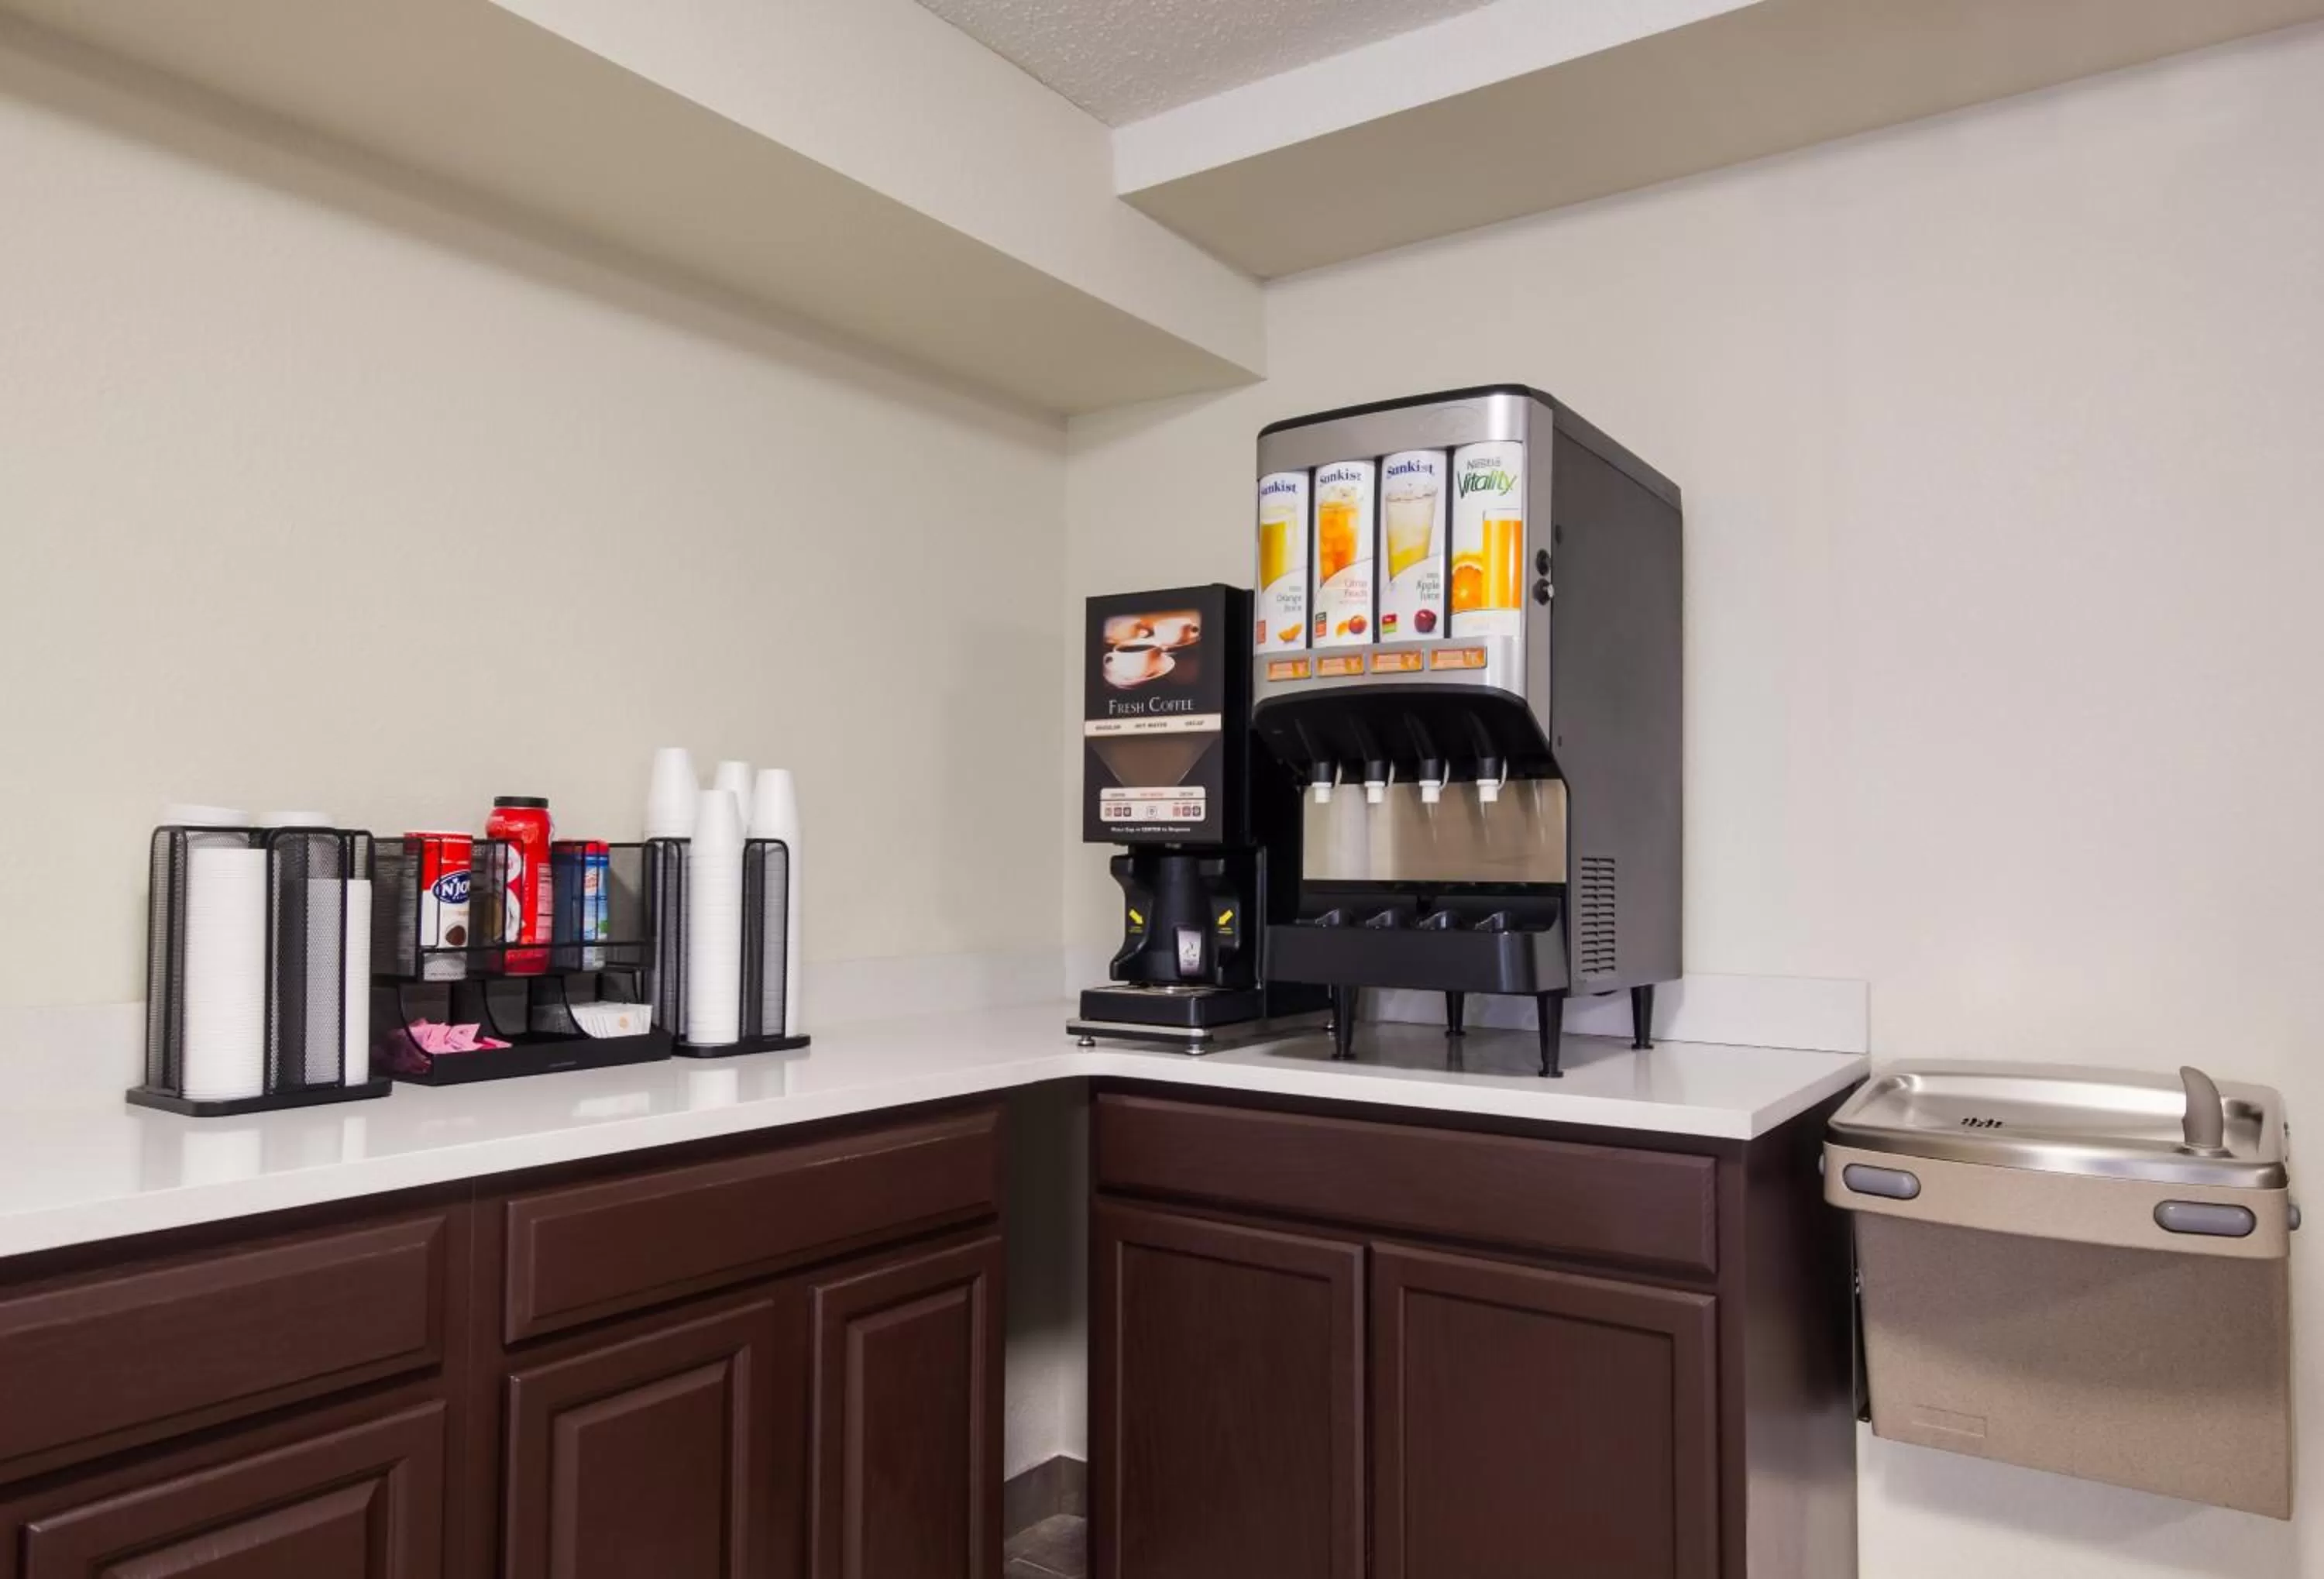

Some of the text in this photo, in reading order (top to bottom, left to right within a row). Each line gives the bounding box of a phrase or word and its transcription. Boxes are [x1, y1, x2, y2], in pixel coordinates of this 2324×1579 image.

[1319, 468, 1362, 487] Sunkist
[1387, 459, 1435, 479] Sunkist
[1456, 470, 1518, 499] Vitality
[1109, 697, 1194, 714] FRESH COFFEE
